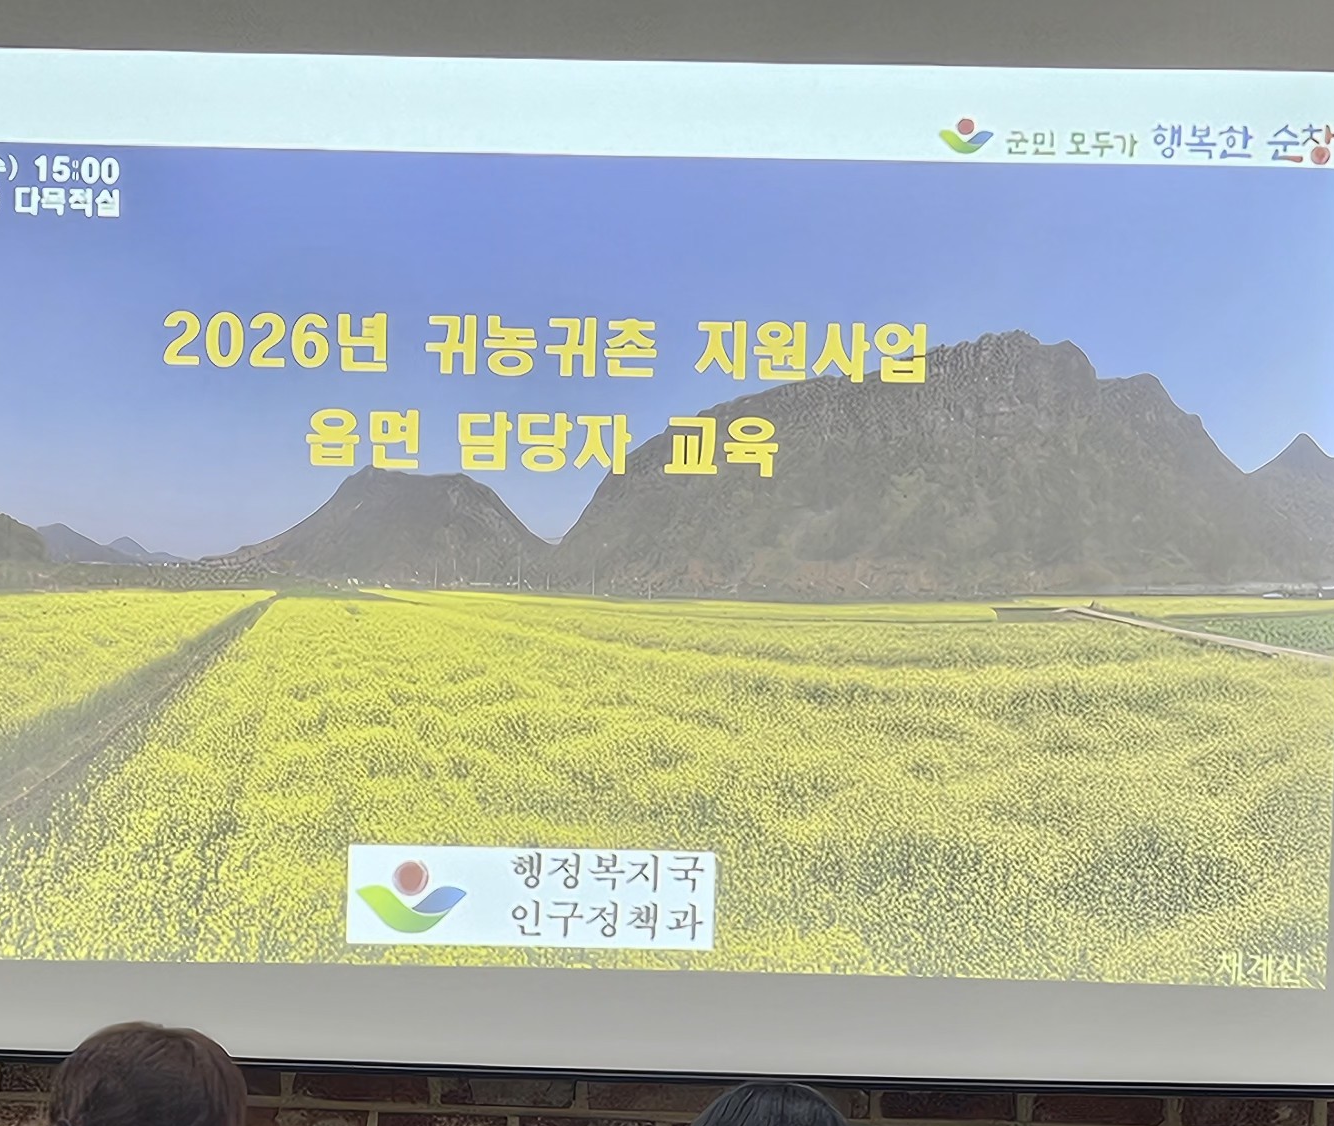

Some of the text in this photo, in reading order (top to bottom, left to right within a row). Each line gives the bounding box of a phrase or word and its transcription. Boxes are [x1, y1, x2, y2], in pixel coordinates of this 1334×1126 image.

[1006, 129, 1055, 157] 군민
[1066, 130, 1138, 159] 모두가
[1152, 123, 1253, 161] 행복한
[34, 154, 120, 185] 15:00
[14, 186, 121, 217] 다목적실
[162, 310, 928, 383] 2026년 귀농귀촌 지원사업
[305, 407, 779, 478] 읍면 담당자 교육
[511, 851, 705, 893] 행정복지국
[511, 899, 703, 941] 인구정책과
[1216, 949, 1305, 985] 채계산
